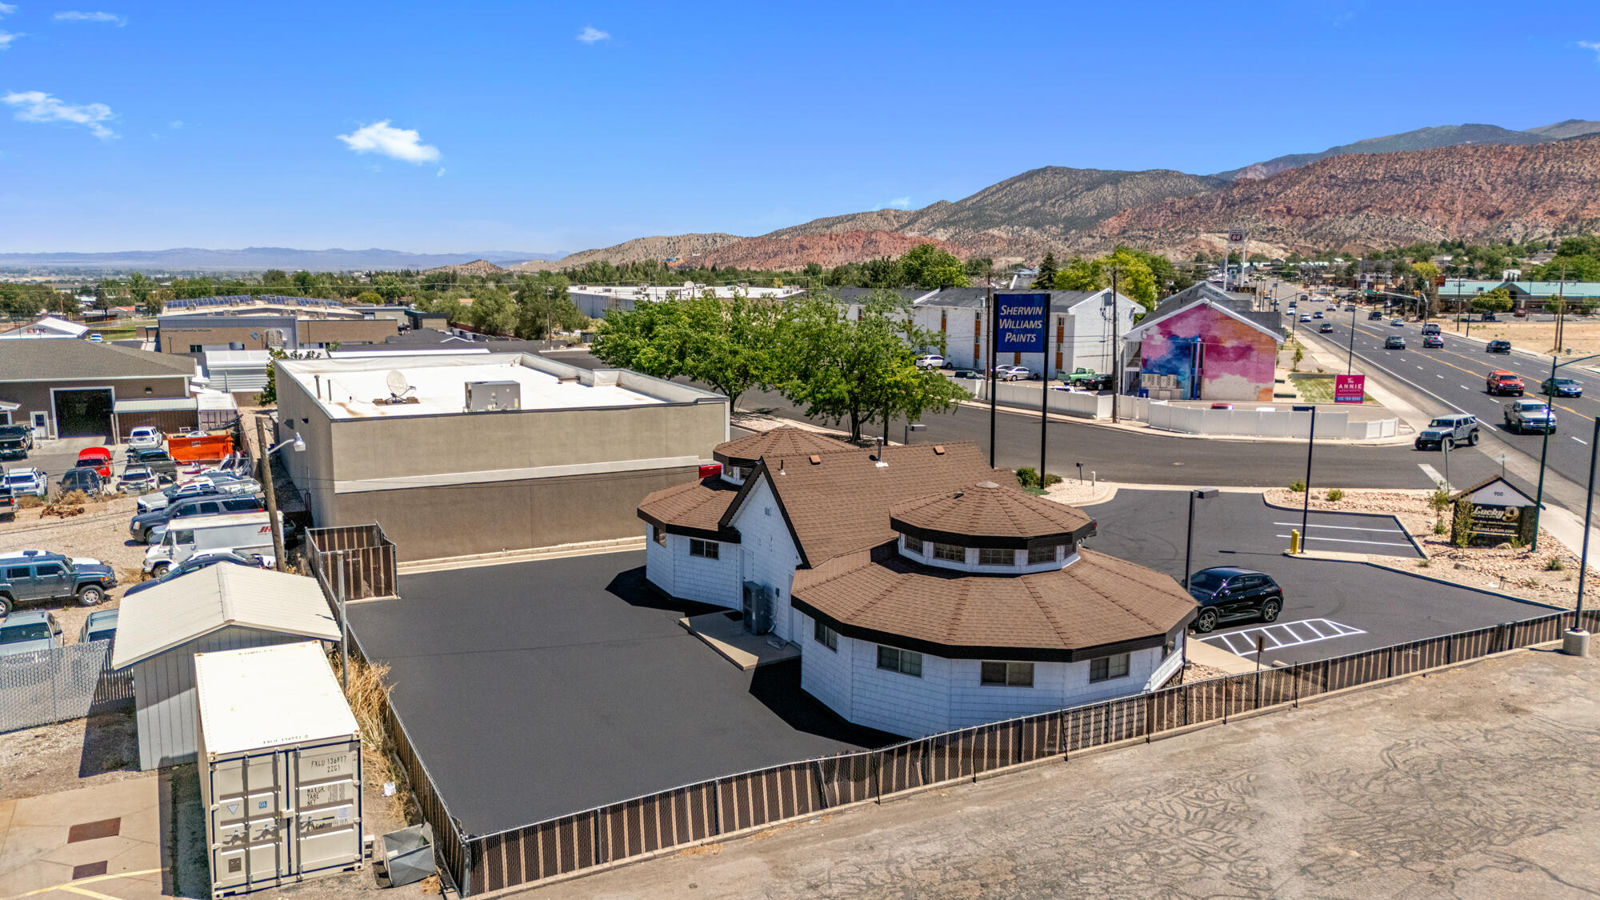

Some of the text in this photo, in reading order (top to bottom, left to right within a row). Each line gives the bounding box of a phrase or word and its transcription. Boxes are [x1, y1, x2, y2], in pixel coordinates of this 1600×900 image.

[1000, 305, 1043, 316] SHERWIN
[999, 319, 1043, 329] WILLIAMS
[1005, 332, 1037, 343] PAINTS
[1473, 506, 1520, 521] Lucky 9
